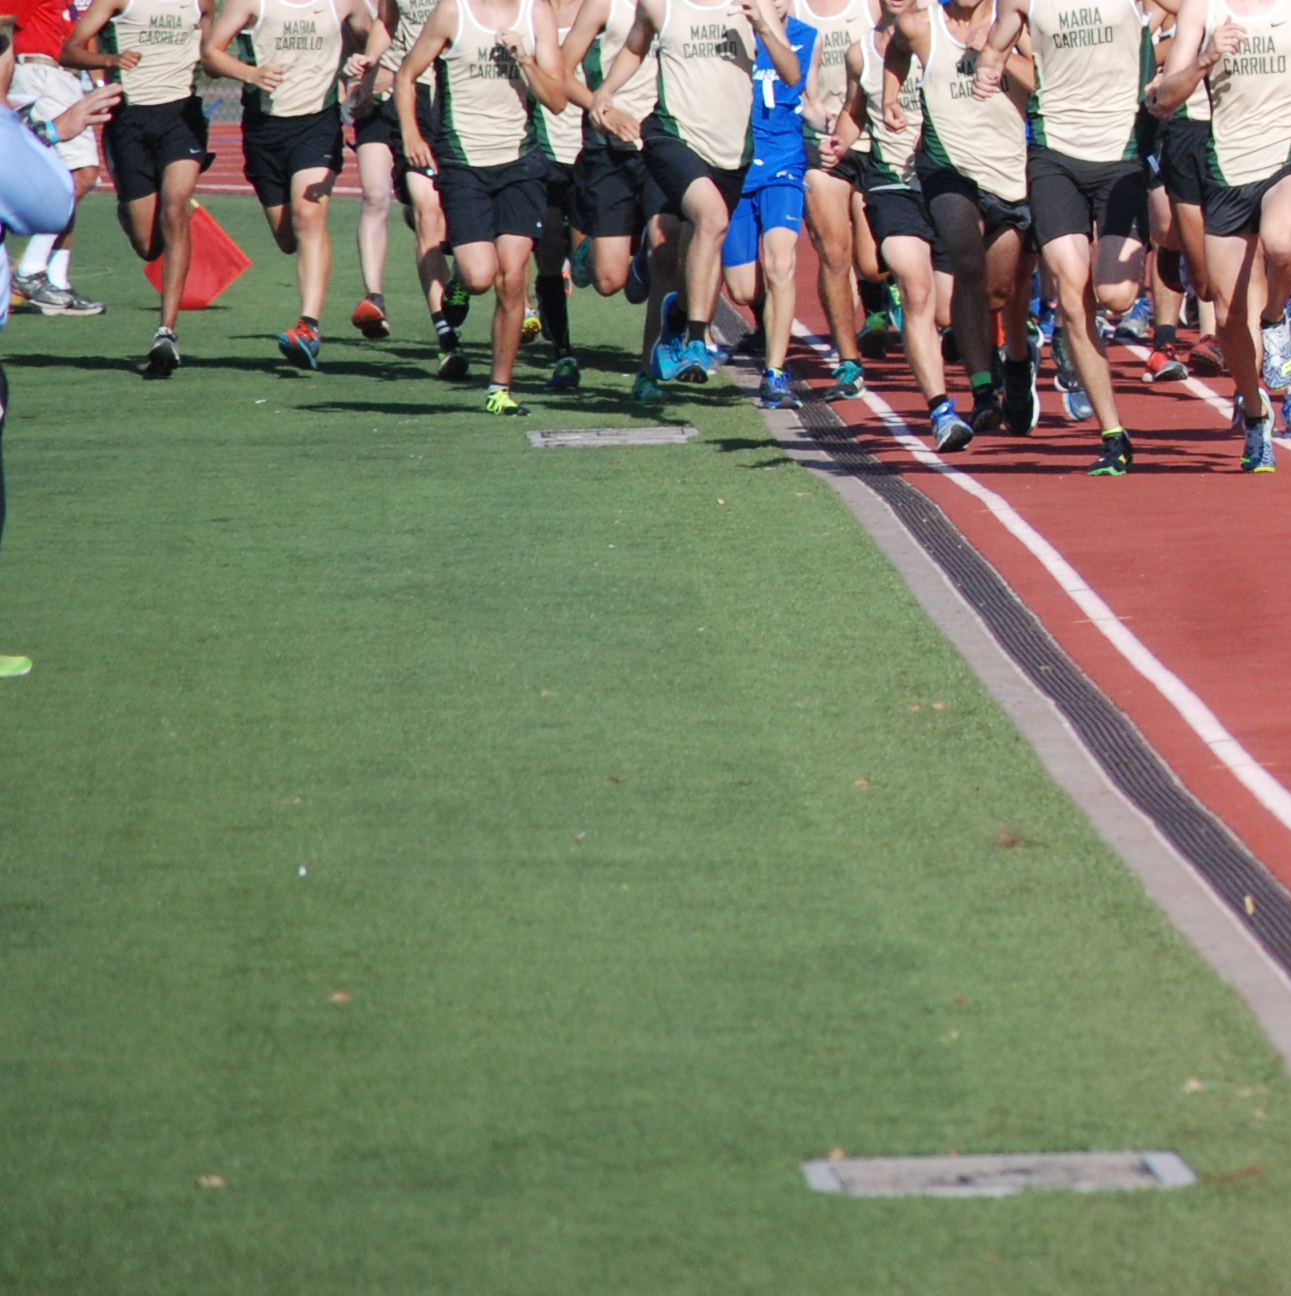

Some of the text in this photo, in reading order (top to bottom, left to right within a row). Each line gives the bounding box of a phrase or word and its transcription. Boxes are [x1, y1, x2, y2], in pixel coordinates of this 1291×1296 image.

[149, 15, 182, 29] MARIA
[1059, 7, 1102, 30] MARIA
[283, 20, 316, 35] MARIA
[690, 24, 727, 41] MARIA
[139, 30, 188, 45] CARRILLO
[276, 36, 323, 51] CARRILLO
[825, 30, 852, 48] ARIA
[1053, 26, 1113, 49] CARRILLO
[683, 41, 738, 59] CARRILLO
[1223, 56, 1286, 76] CARRILLO
